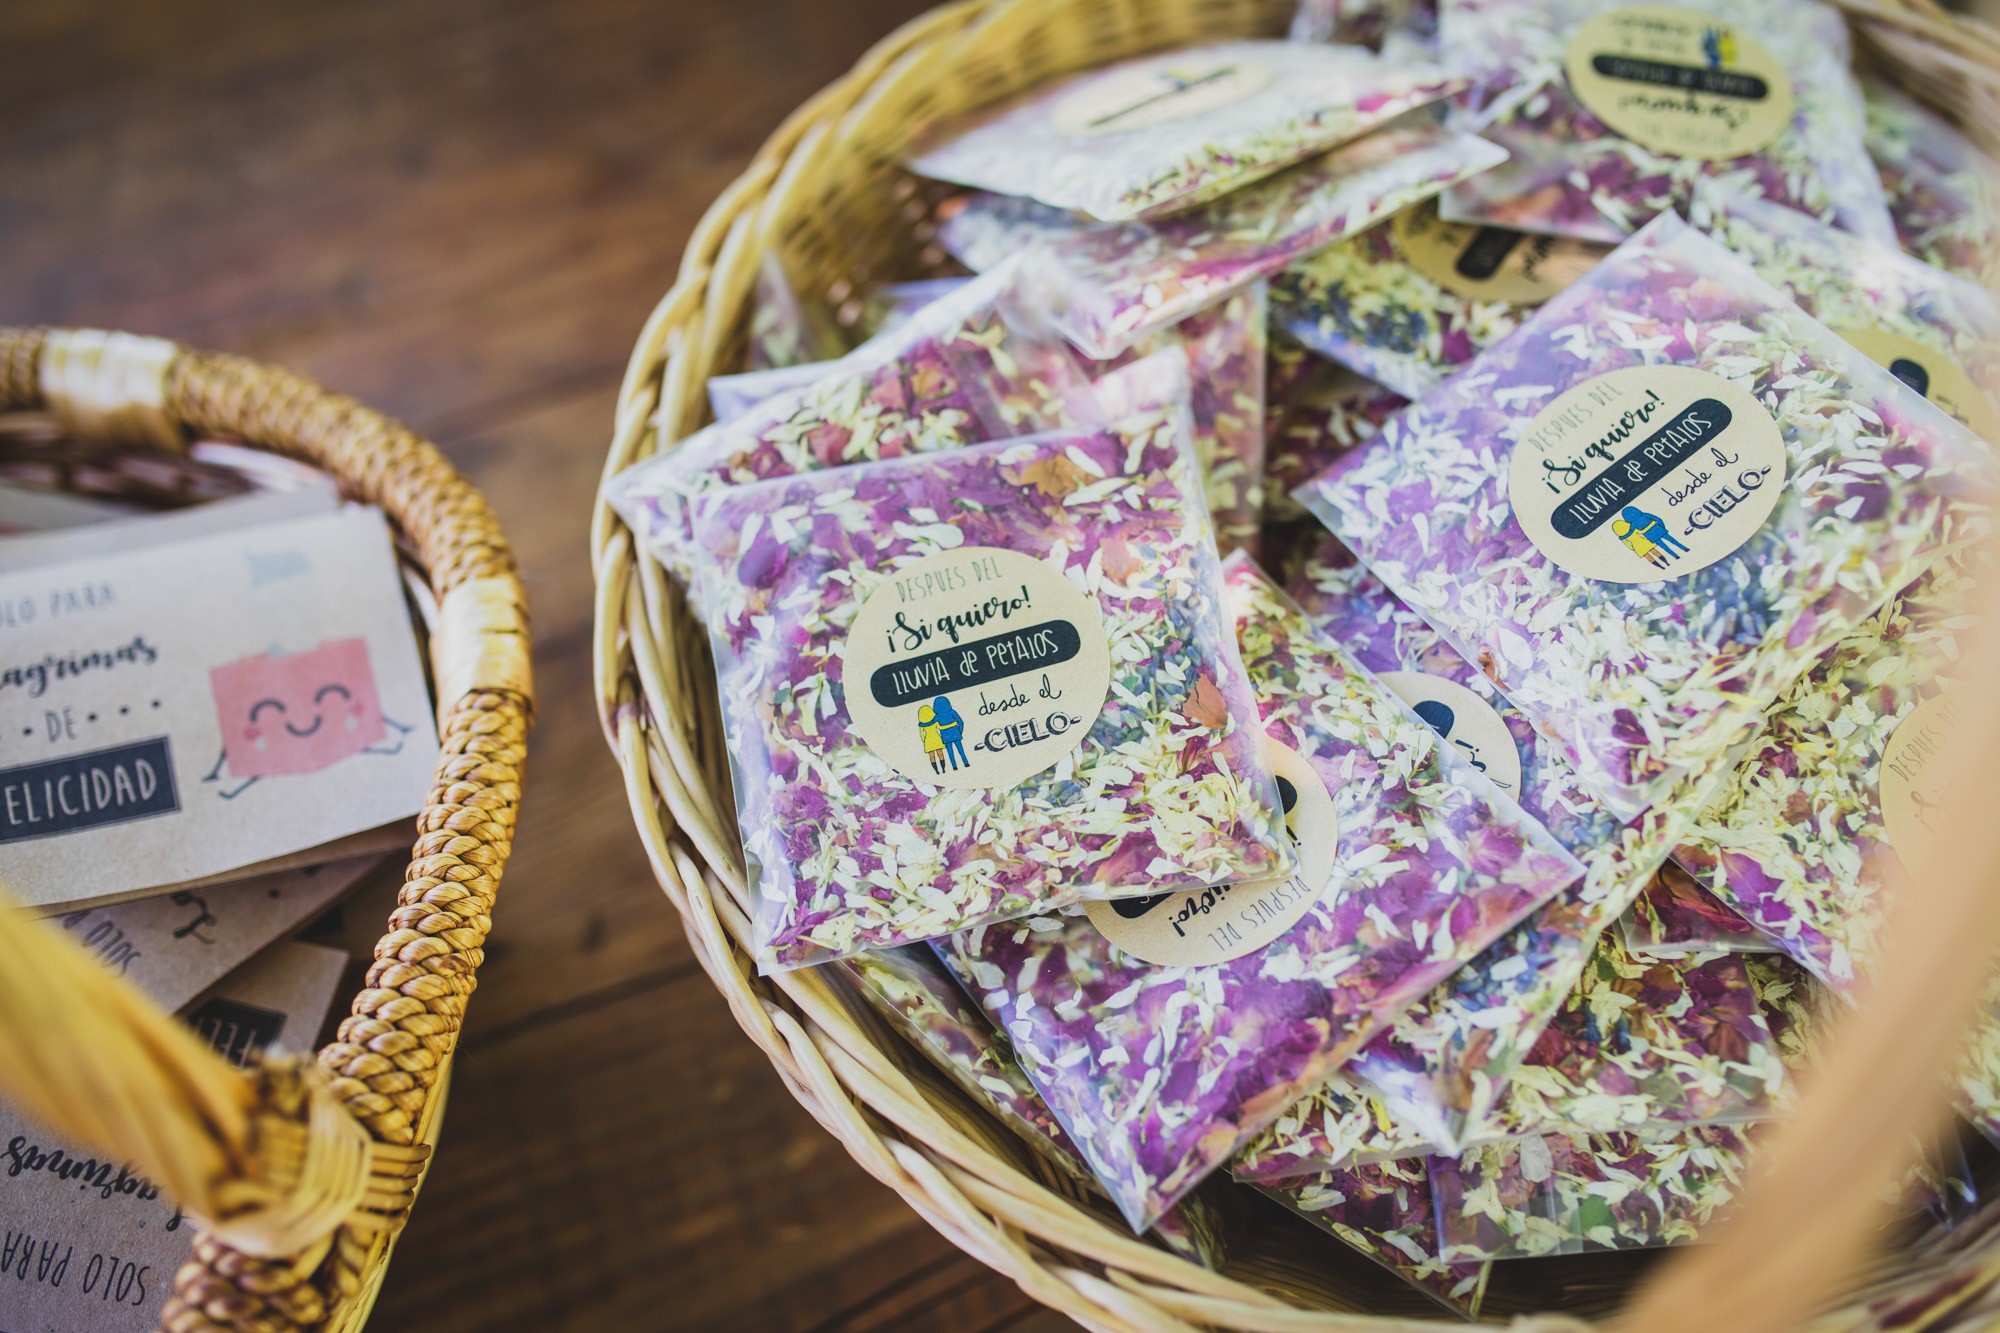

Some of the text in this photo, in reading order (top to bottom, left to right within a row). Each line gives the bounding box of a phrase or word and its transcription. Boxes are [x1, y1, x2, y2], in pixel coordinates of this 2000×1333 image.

[1527, 380, 1623, 452] DESPUES DEL
[1584, 388, 1666, 462] quiero!
[1623, 459, 1649, 483] de
[1660, 447, 1739, 507] desde el
[895, 556, 1003, 604] DESPUES DEL
[885, 584, 1032, 653] ¡Si quiero!
[0, 632, 158, 698] agrimas
[959, 650, 979, 677] de
[978, 673, 1062, 716] desde el
[44, 706, 77, 744] DE
[1888, 723, 1947, 783] DESPUES
[4, 757, 157, 826] ELICIDAD
[1167, 882, 1240, 938] iero!
[1206, 874, 1312, 952] DESPUES DEL
[0, 1229, 151, 1307] SOLO PARA
